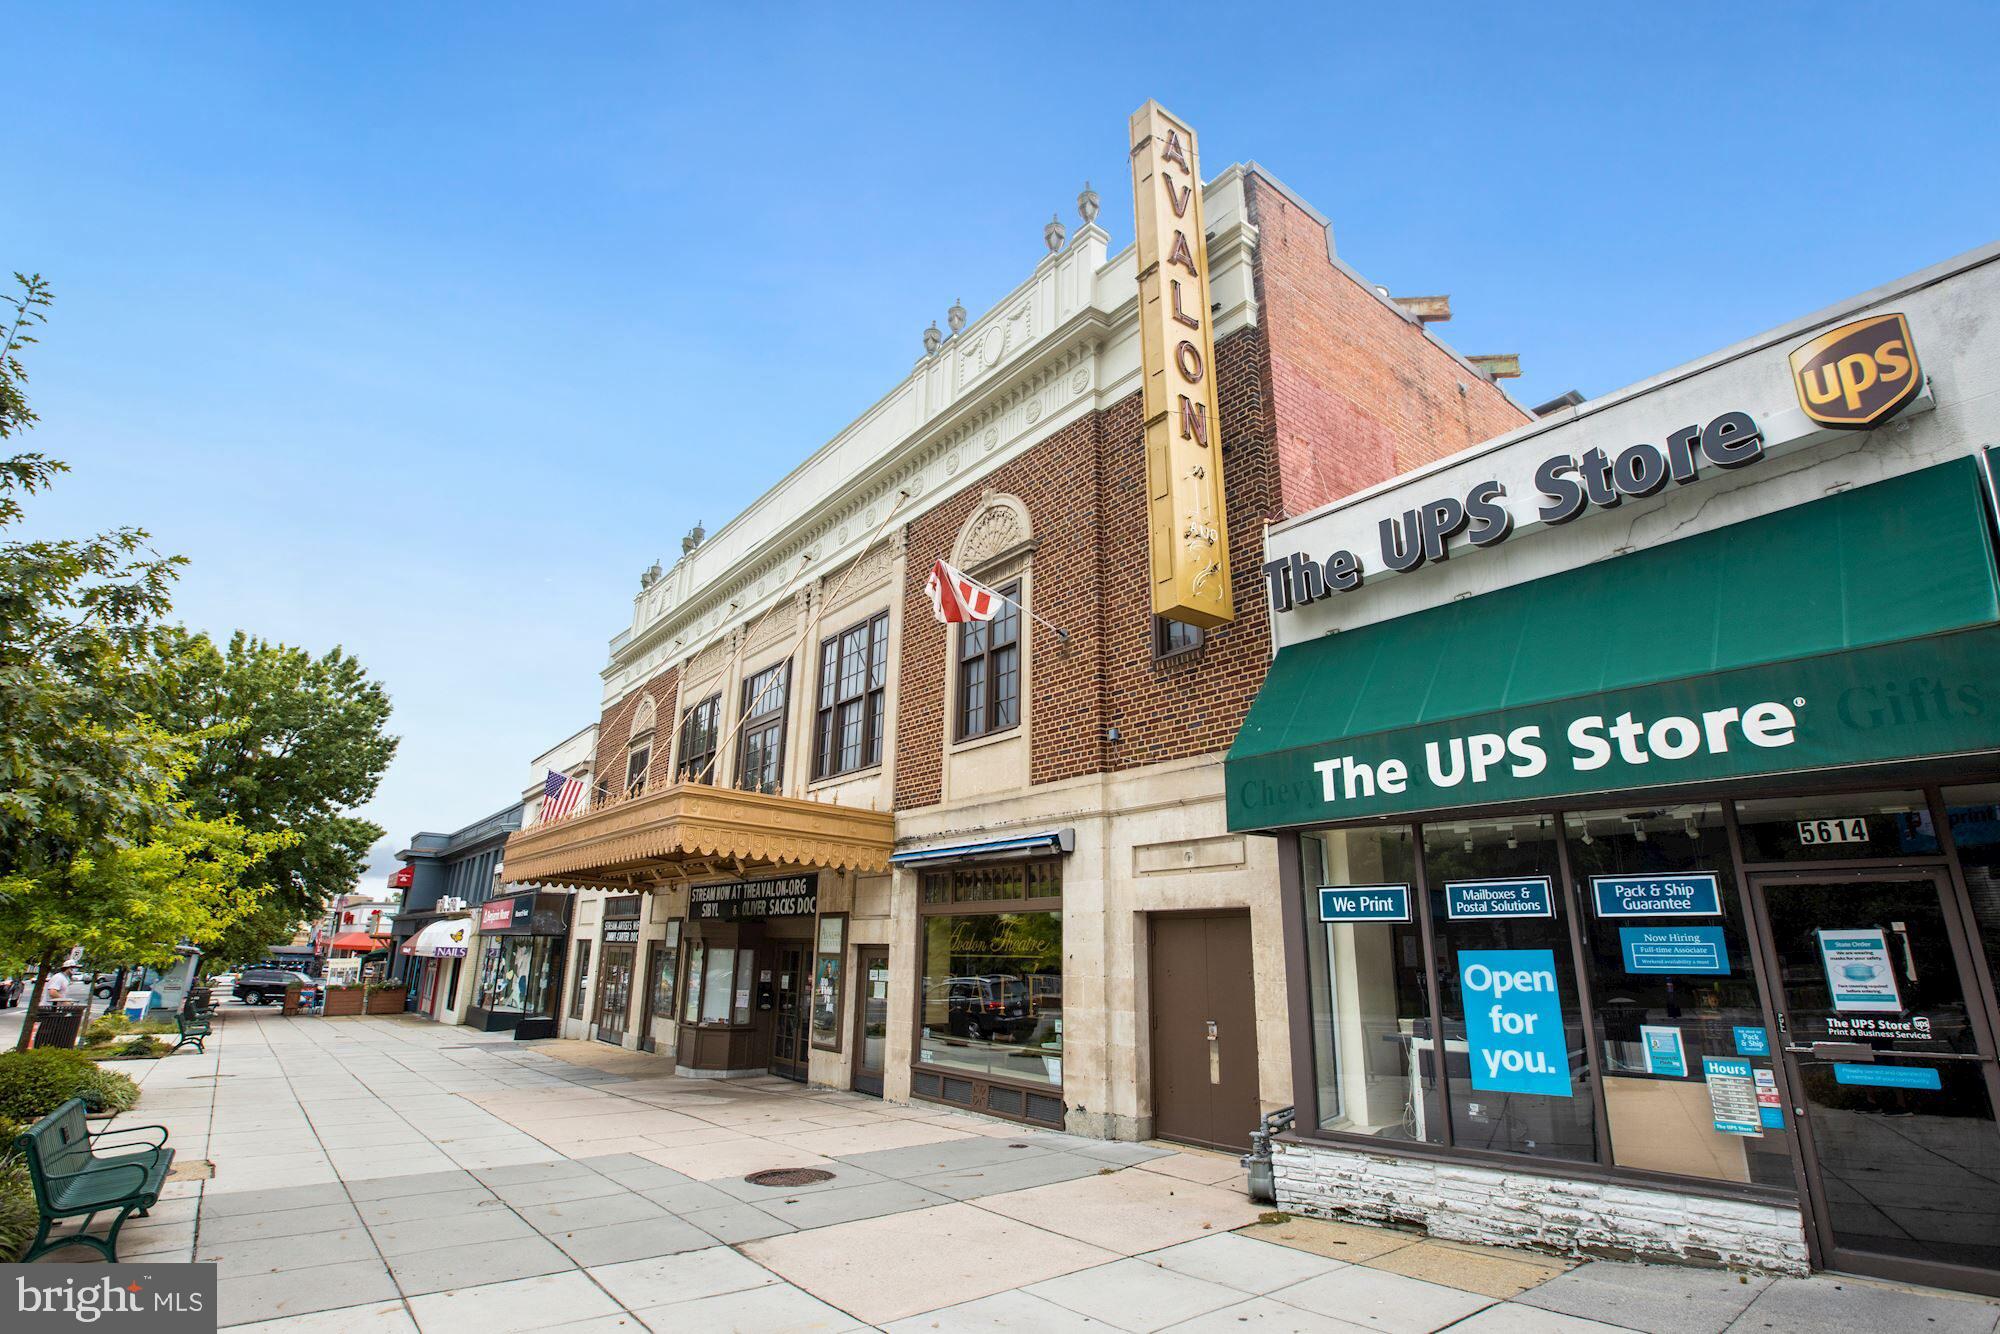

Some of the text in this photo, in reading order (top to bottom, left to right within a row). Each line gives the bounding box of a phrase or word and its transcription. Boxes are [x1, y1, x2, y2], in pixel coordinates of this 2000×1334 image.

[1162, 128, 1208, 449] AVALON
[1802, 338, 1910, 411] ups
[1262, 411, 1764, 613] The UPS Store
[1313, 756, 1408, 802] The
[1425, 725, 1547, 788] UPS
[1800, 819, 1867, 844] 5614
[691, 887, 716, 902] STREAM
[716, 885, 731, 900] NOW
[731, 884, 742, 899] AT
[1462, 887, 1531, 900] Mailboxes &
[1615, 883, 1695, 898] Pack & Ship
[701, 902, 719, 917] SIBYL
[741, 899, 767, 916] OLIVER
[769, 898, 796, 915] SACKS
[797, 896, 816, 914] DOC
[1333, 895, 1394, 912] We Print
[1456, 899, 1541, 913] Postal Solutions
[1622, 898, 1691, 910] Guarantee
[1643, 933, 1701, 943] Now Hiring
[436, 946, 467, 957] NAILS
[1464, 964, 1555, 999] Open
[1488, 1004, 1539, 1035] for
[1826, 1017, 1849, 1028] The
[1850, 1018, 1876, 1029] UPS
[1878, 1020, 1911, 1031] Store
[1828, 1028, 1932, 1039] Print & Business Services
[1748, 1040, 1764, 1048] Ship
[1481, 1048, 1557, 1078] you.
[1708, 1062, 1746, 1075] Hours
